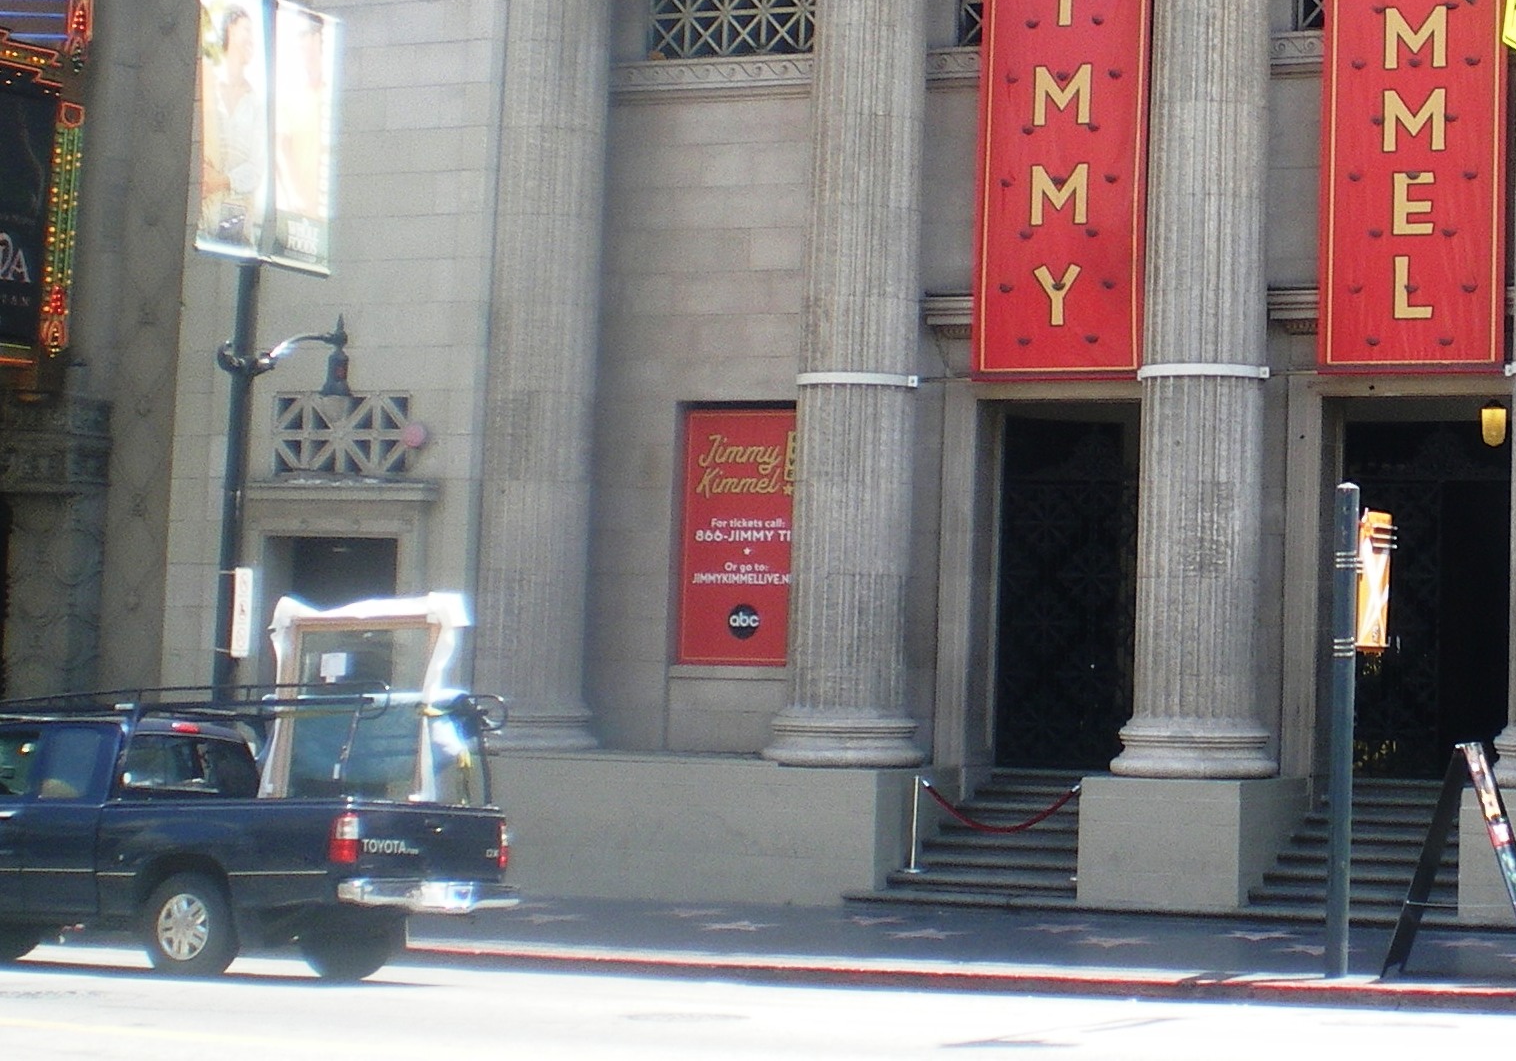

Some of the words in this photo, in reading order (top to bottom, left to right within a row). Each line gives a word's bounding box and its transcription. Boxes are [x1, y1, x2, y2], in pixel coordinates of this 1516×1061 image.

[698, 434, 784, 475] Jimmy
[696, 466, 781, 499] Kimmel
[710, 518, 728, 529] For
[729, 518, 763, 529] tickets
[764, 518, 786, 529] call:
[695, 529, 775, 542] 866-JIMMY
[778, 529, 792, 542] TI
[724, 561, 738, 572] Or
[739, 563, 753, 574] go
[754, 561, 770, 572] to:
[692, 573, 791, 586] JIMMYKIMMELLIVE.N
[729, 611, 760, 628] abc
[361, 838, 406, 855] TOYOTA
